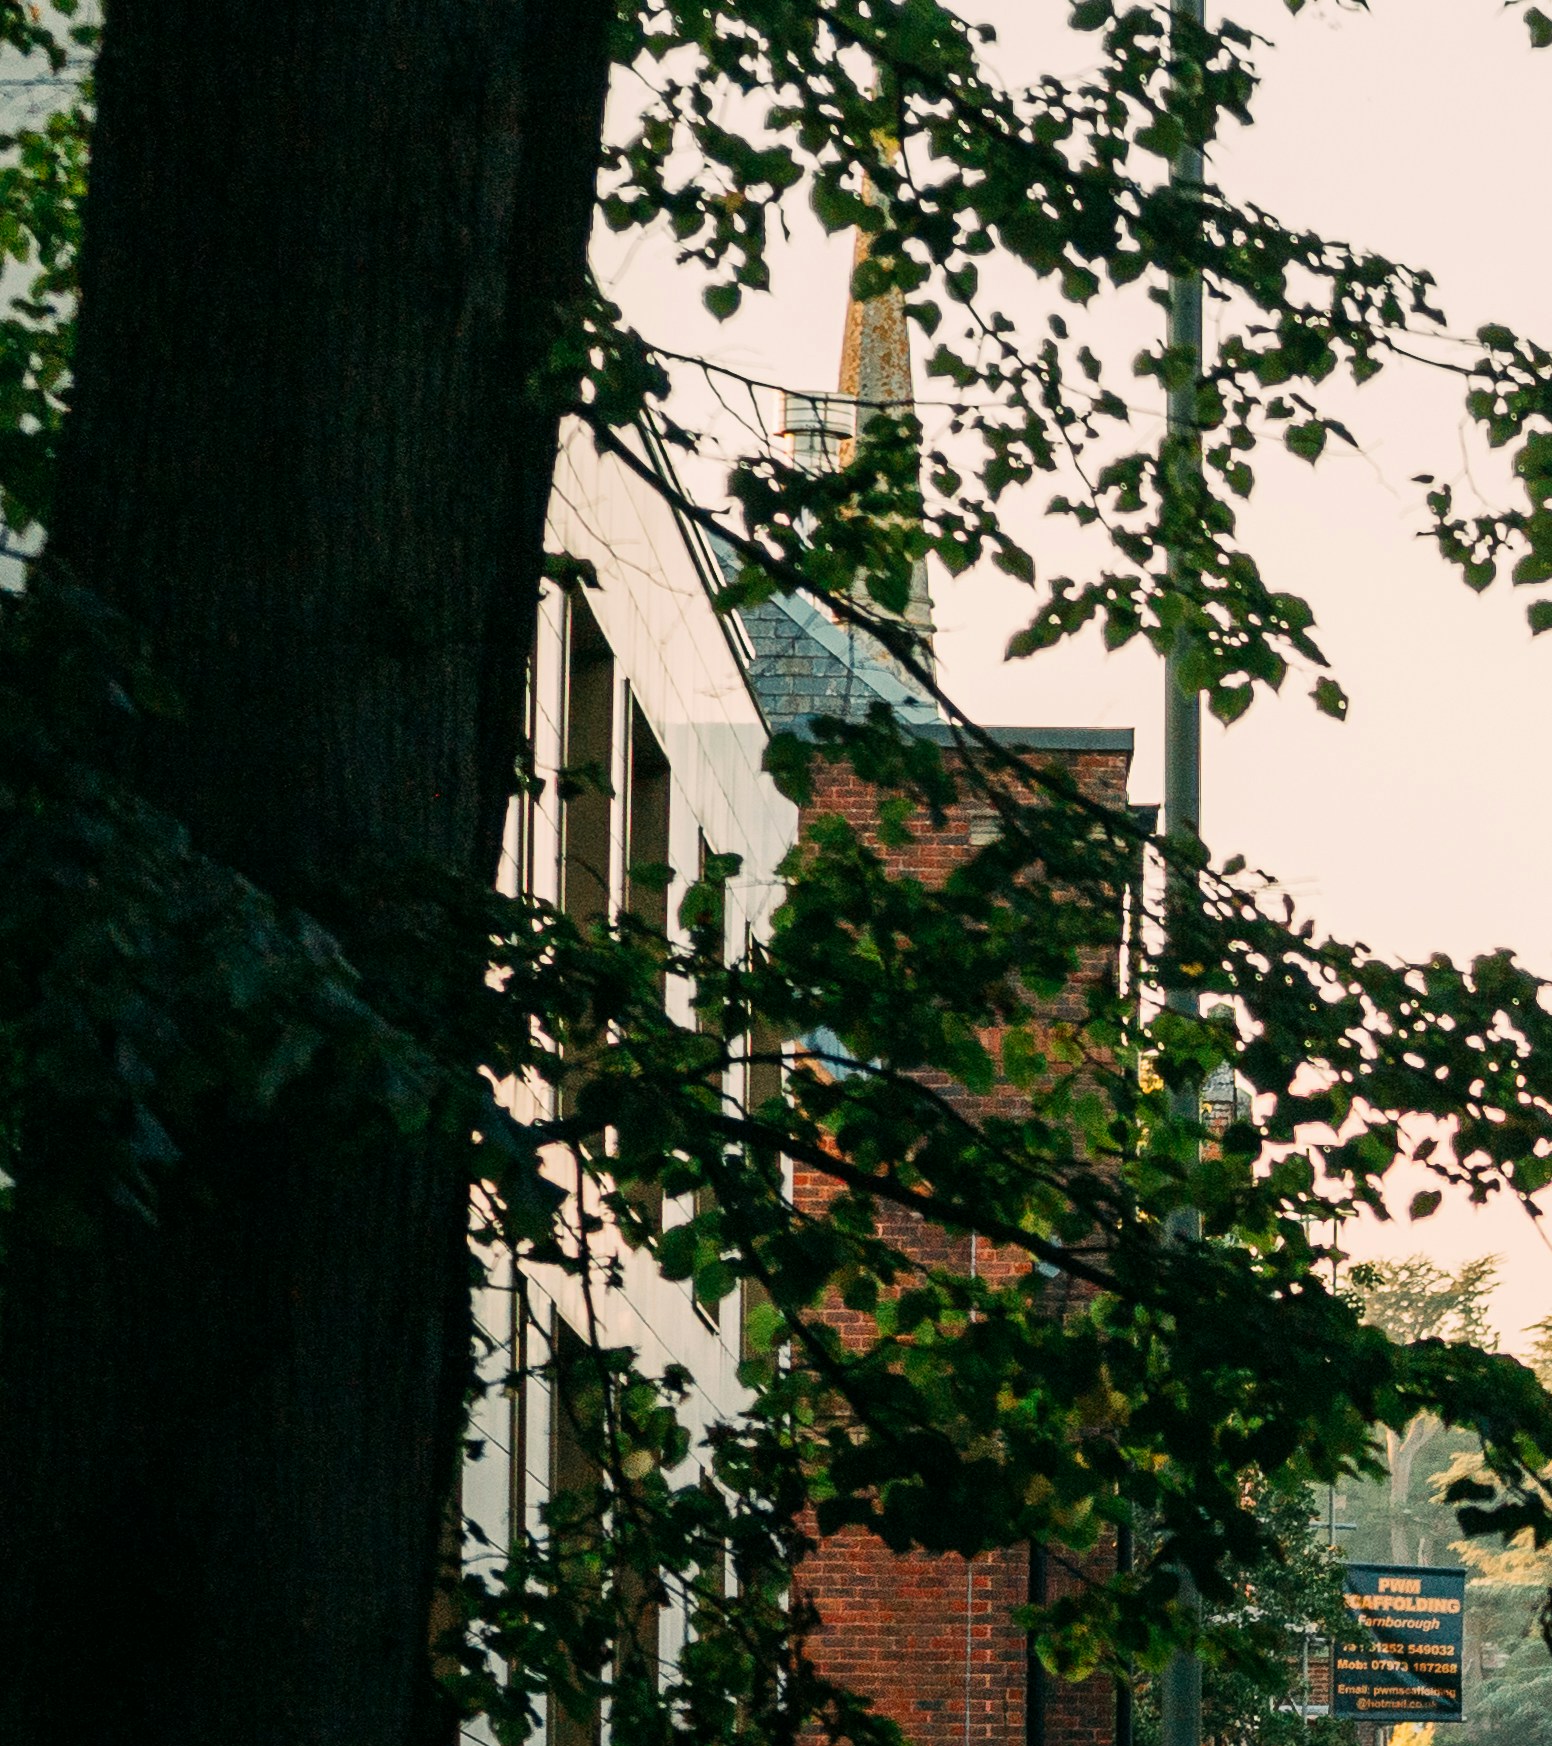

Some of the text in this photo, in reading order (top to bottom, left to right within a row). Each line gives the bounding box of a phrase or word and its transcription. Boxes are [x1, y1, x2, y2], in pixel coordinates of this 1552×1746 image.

[1378, 1577, 1421, 1594] PWM
[1358, 1613, 1441, 1632] Farnborough
[1408, 1644, 1455, 1656] 549032
[1337, 1659, 1367, 1670] Mob:
